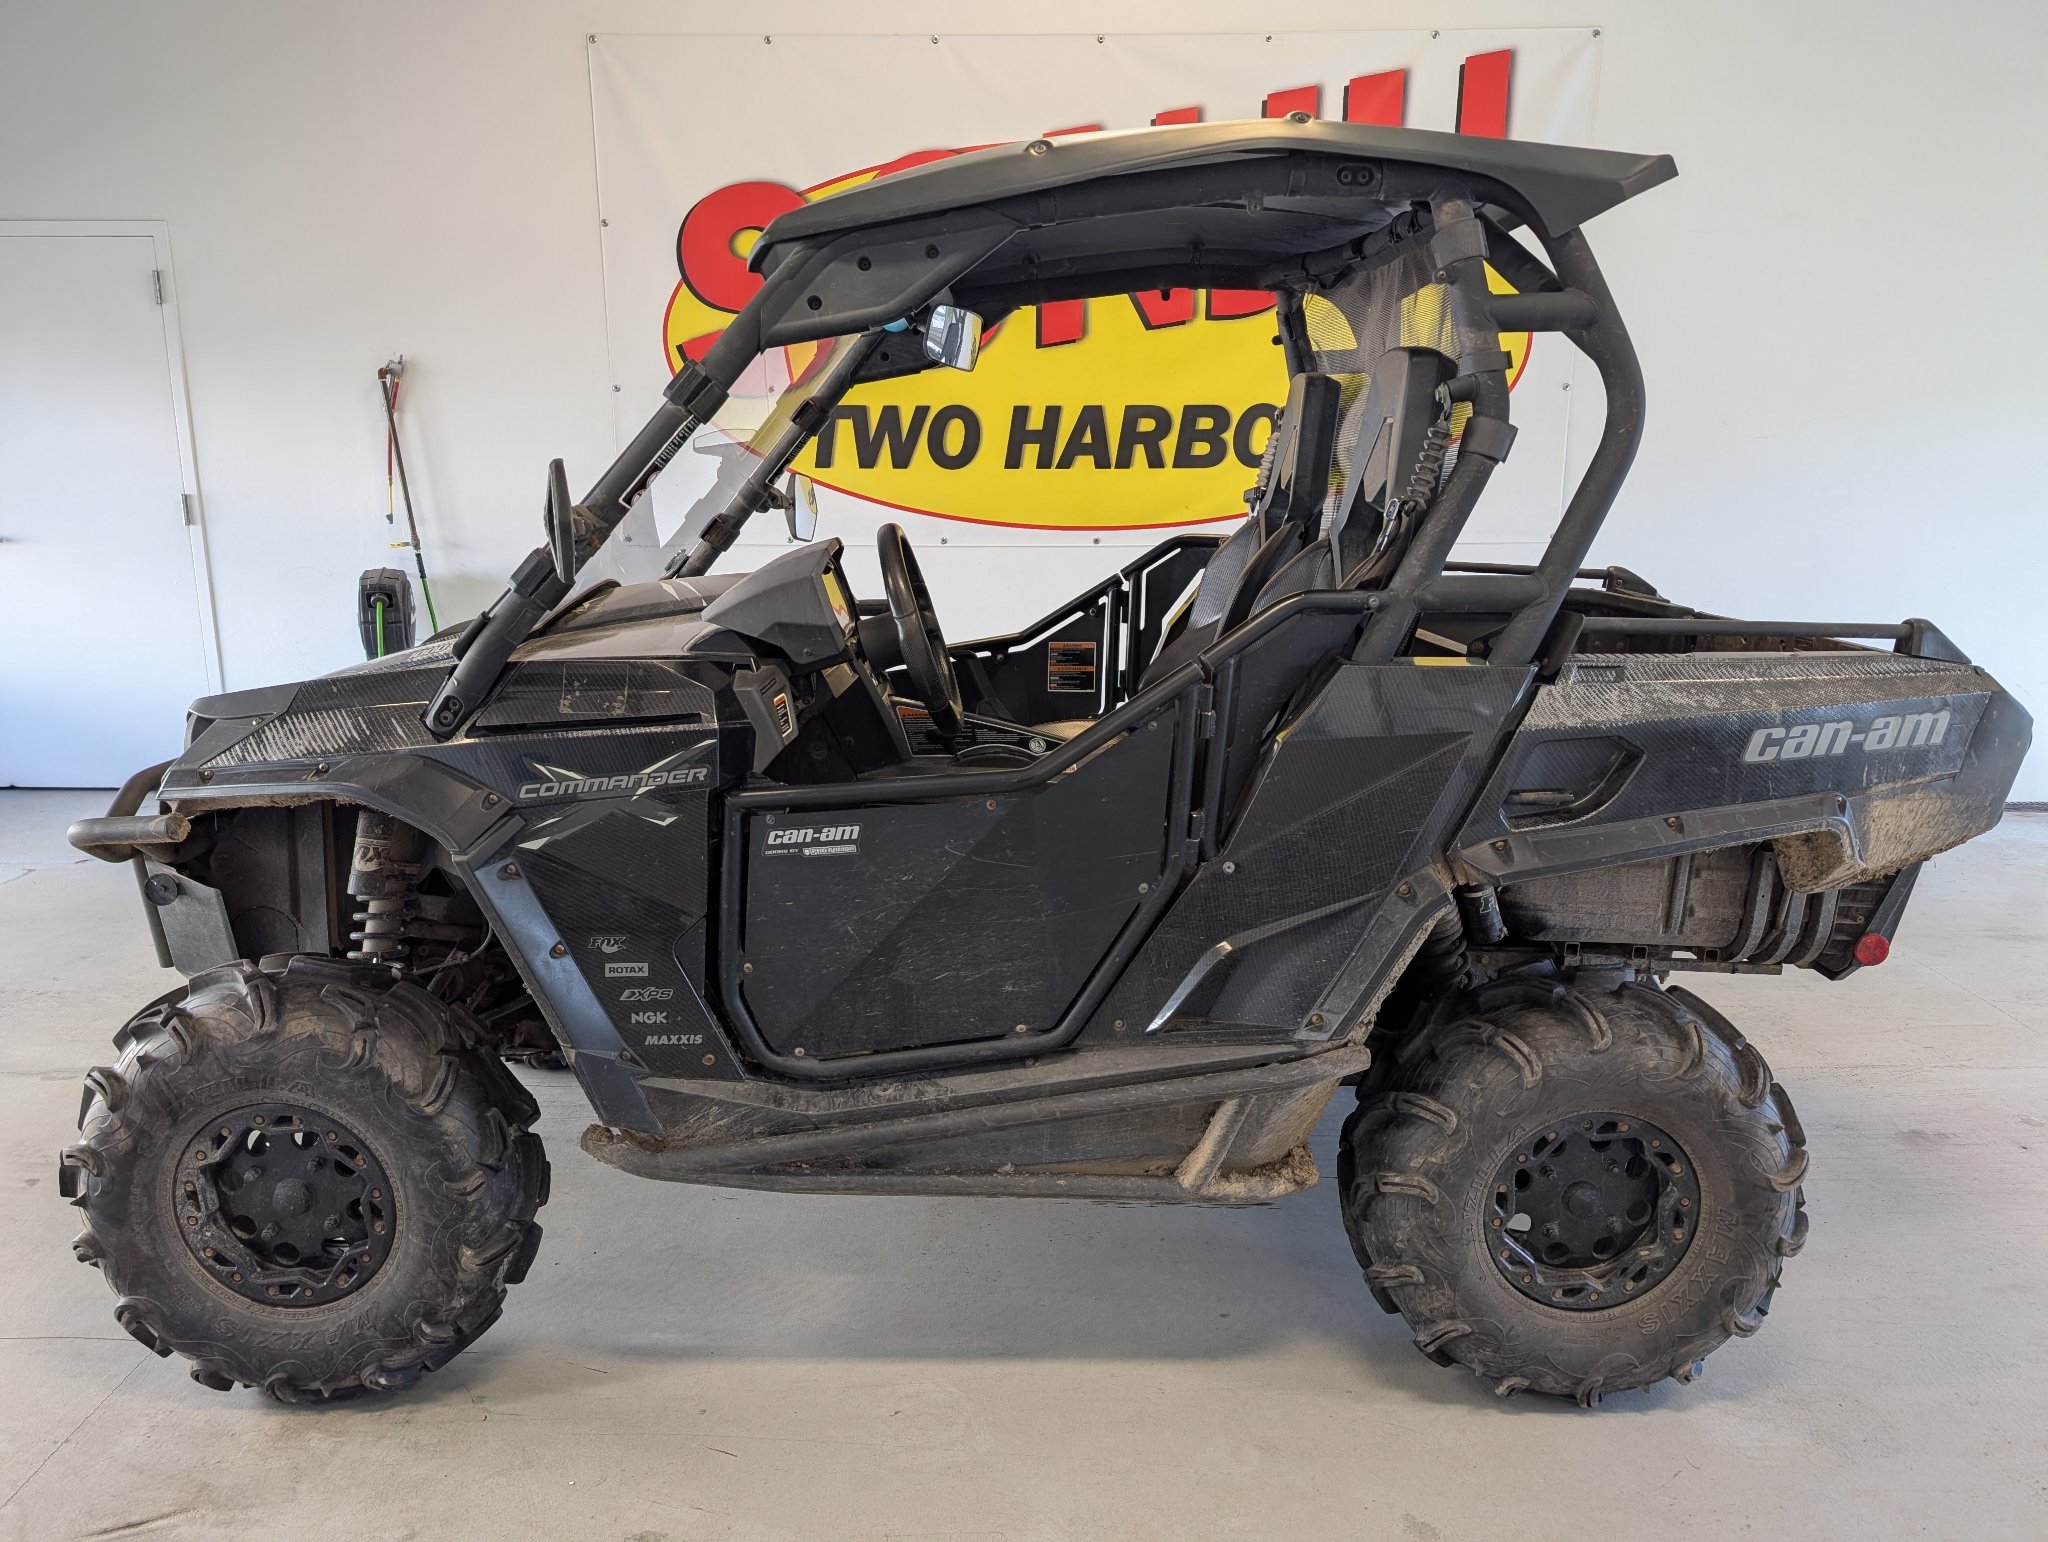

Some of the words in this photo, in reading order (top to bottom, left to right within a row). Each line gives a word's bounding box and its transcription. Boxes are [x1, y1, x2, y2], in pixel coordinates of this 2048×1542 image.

[815, 404, 982, 470] TWO
[1744, 709, 1951, 762] can-am
[518, 767, 709, 799] COMMANDER
[767, 826, 860, 844] can-am
[588, 936, 627, 953] FOX
[608, 965, 645, 974] ROTAX
[631, 986, 674, 1001] XPS
[631, 1011, 668, 1024] NGK
[644, 1034, 703, 1045] MAXXIS
[1638, 1206, 1742, 1336] MAXXIS
